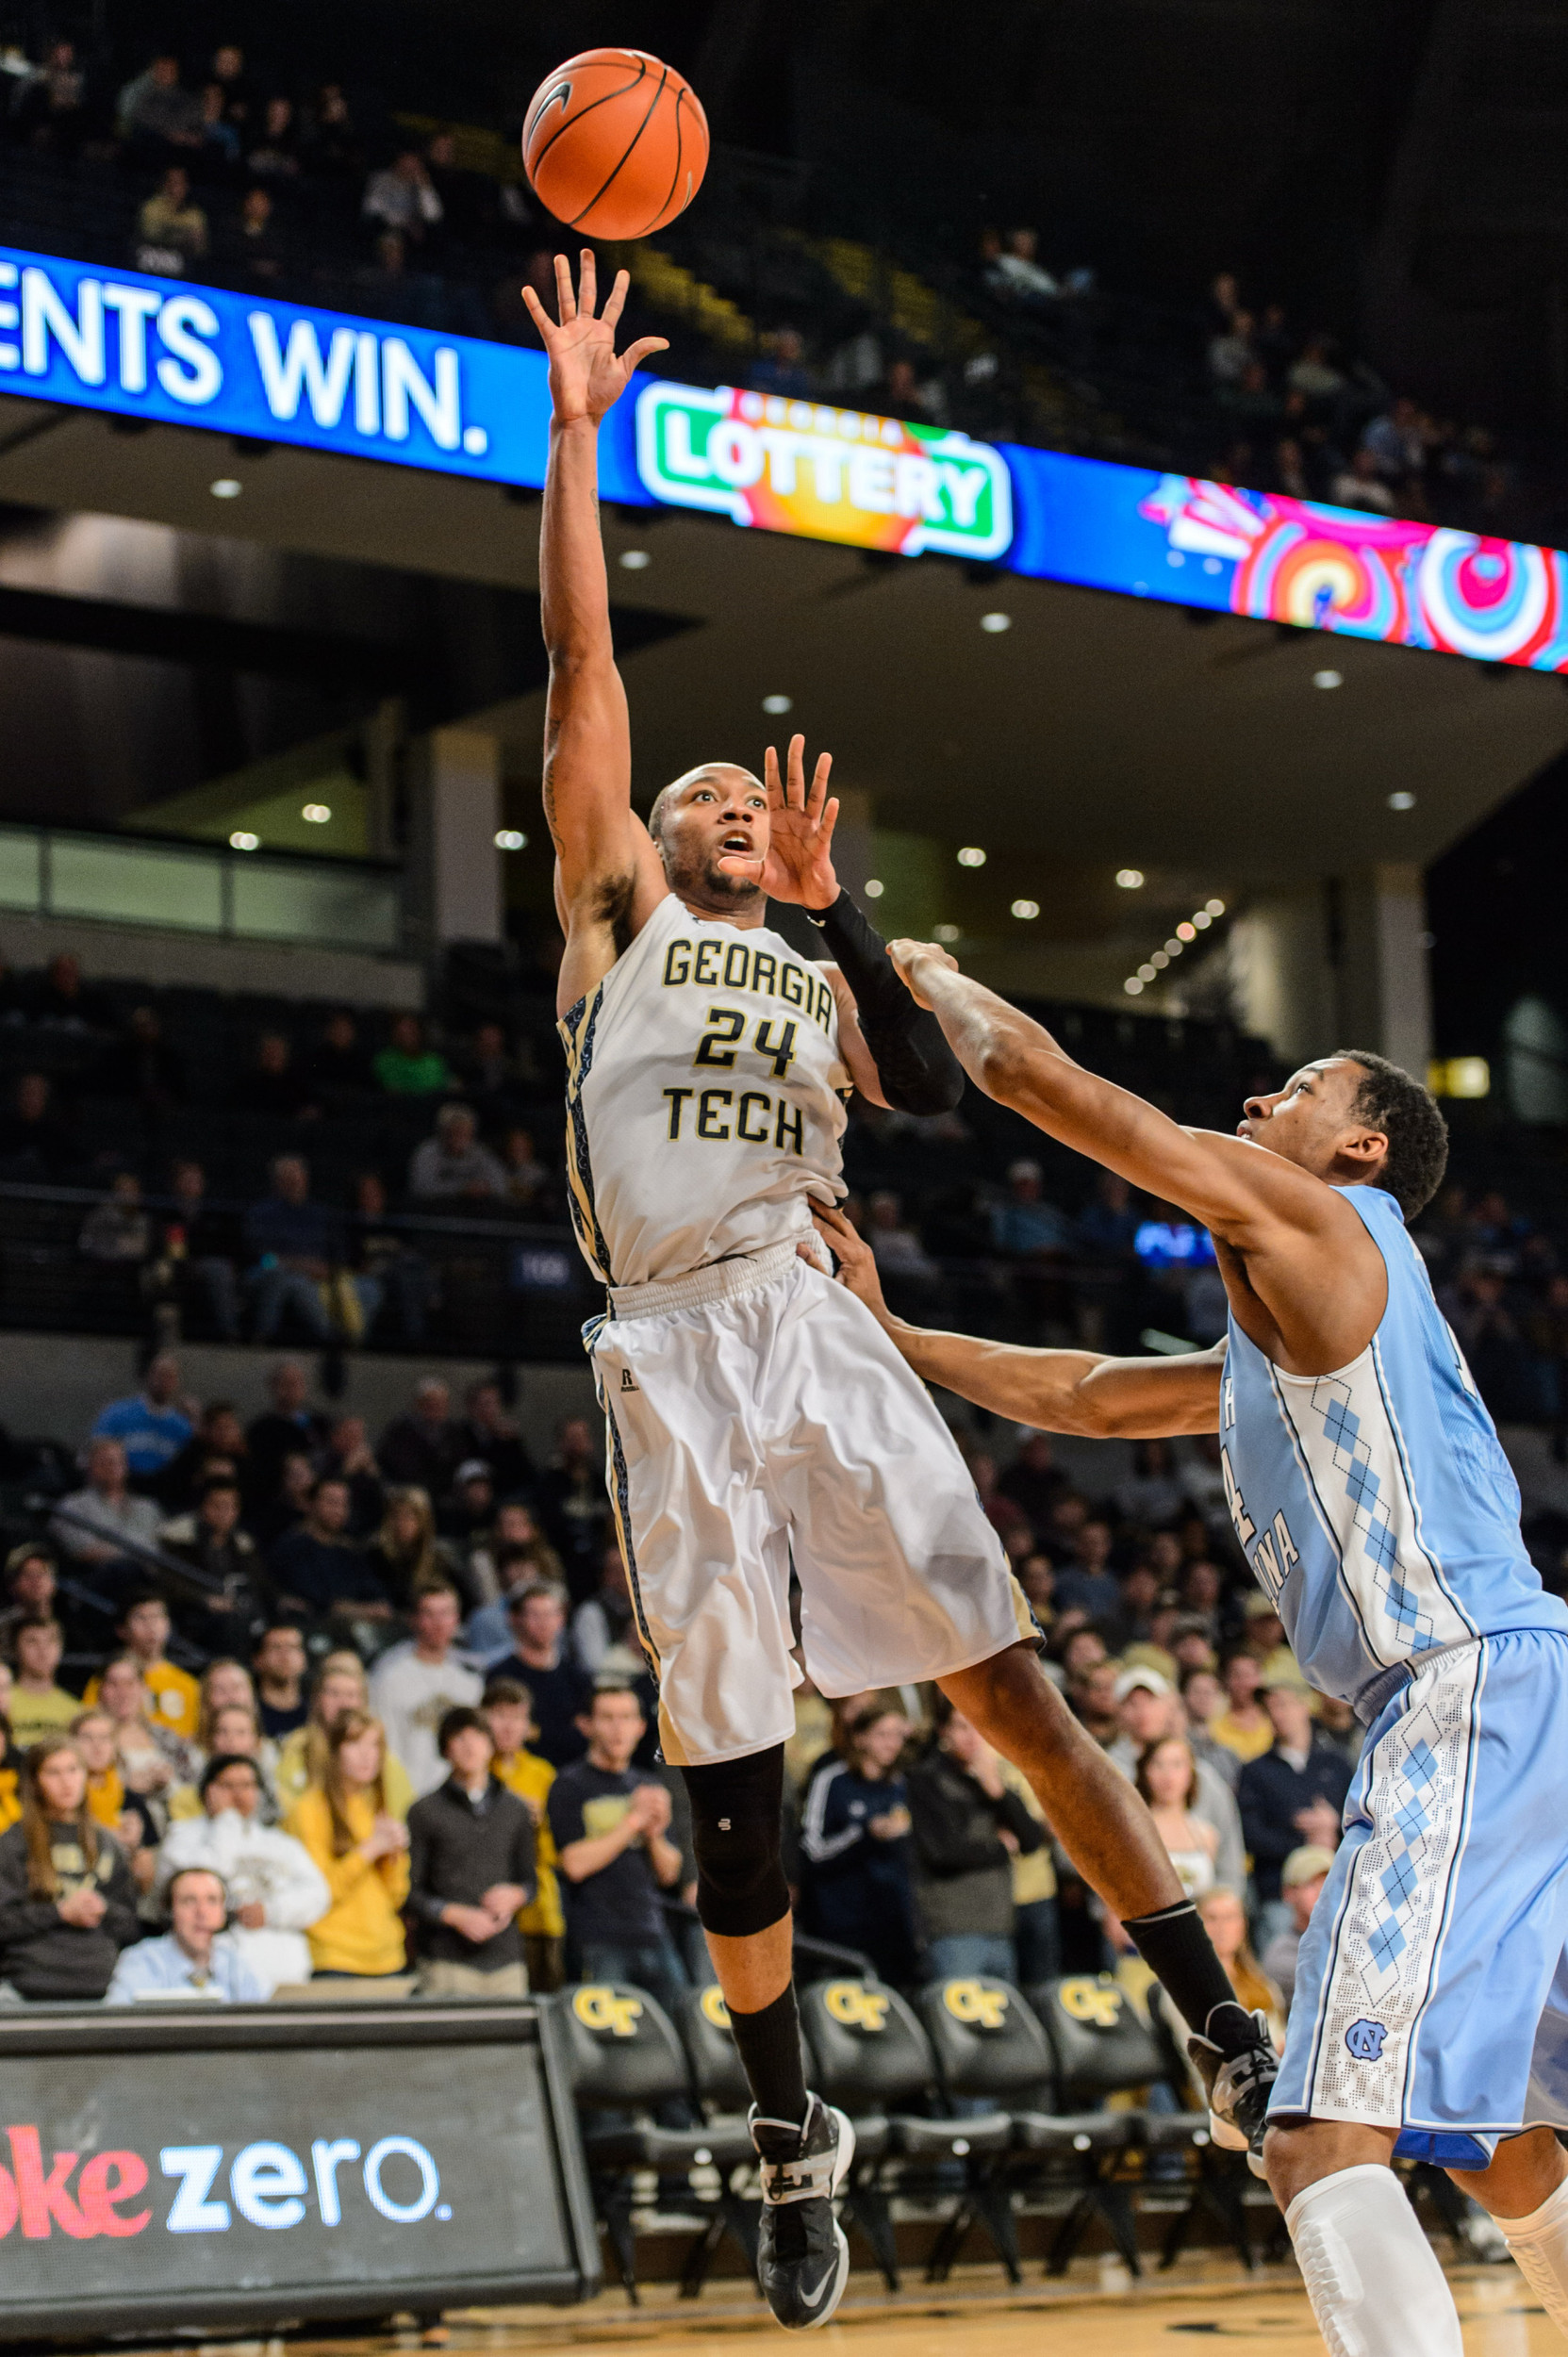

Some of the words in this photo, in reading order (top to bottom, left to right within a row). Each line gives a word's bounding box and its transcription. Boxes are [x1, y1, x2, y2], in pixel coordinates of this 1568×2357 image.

[248, 311, 488, 455] WIN.
[664, 409, 989, 528] LOTTERY
[662, 937, 833, 1037] GEORGIA
[693, 1005, 800, 1080] 24
[662, 1087, 804, 1158] TECH
